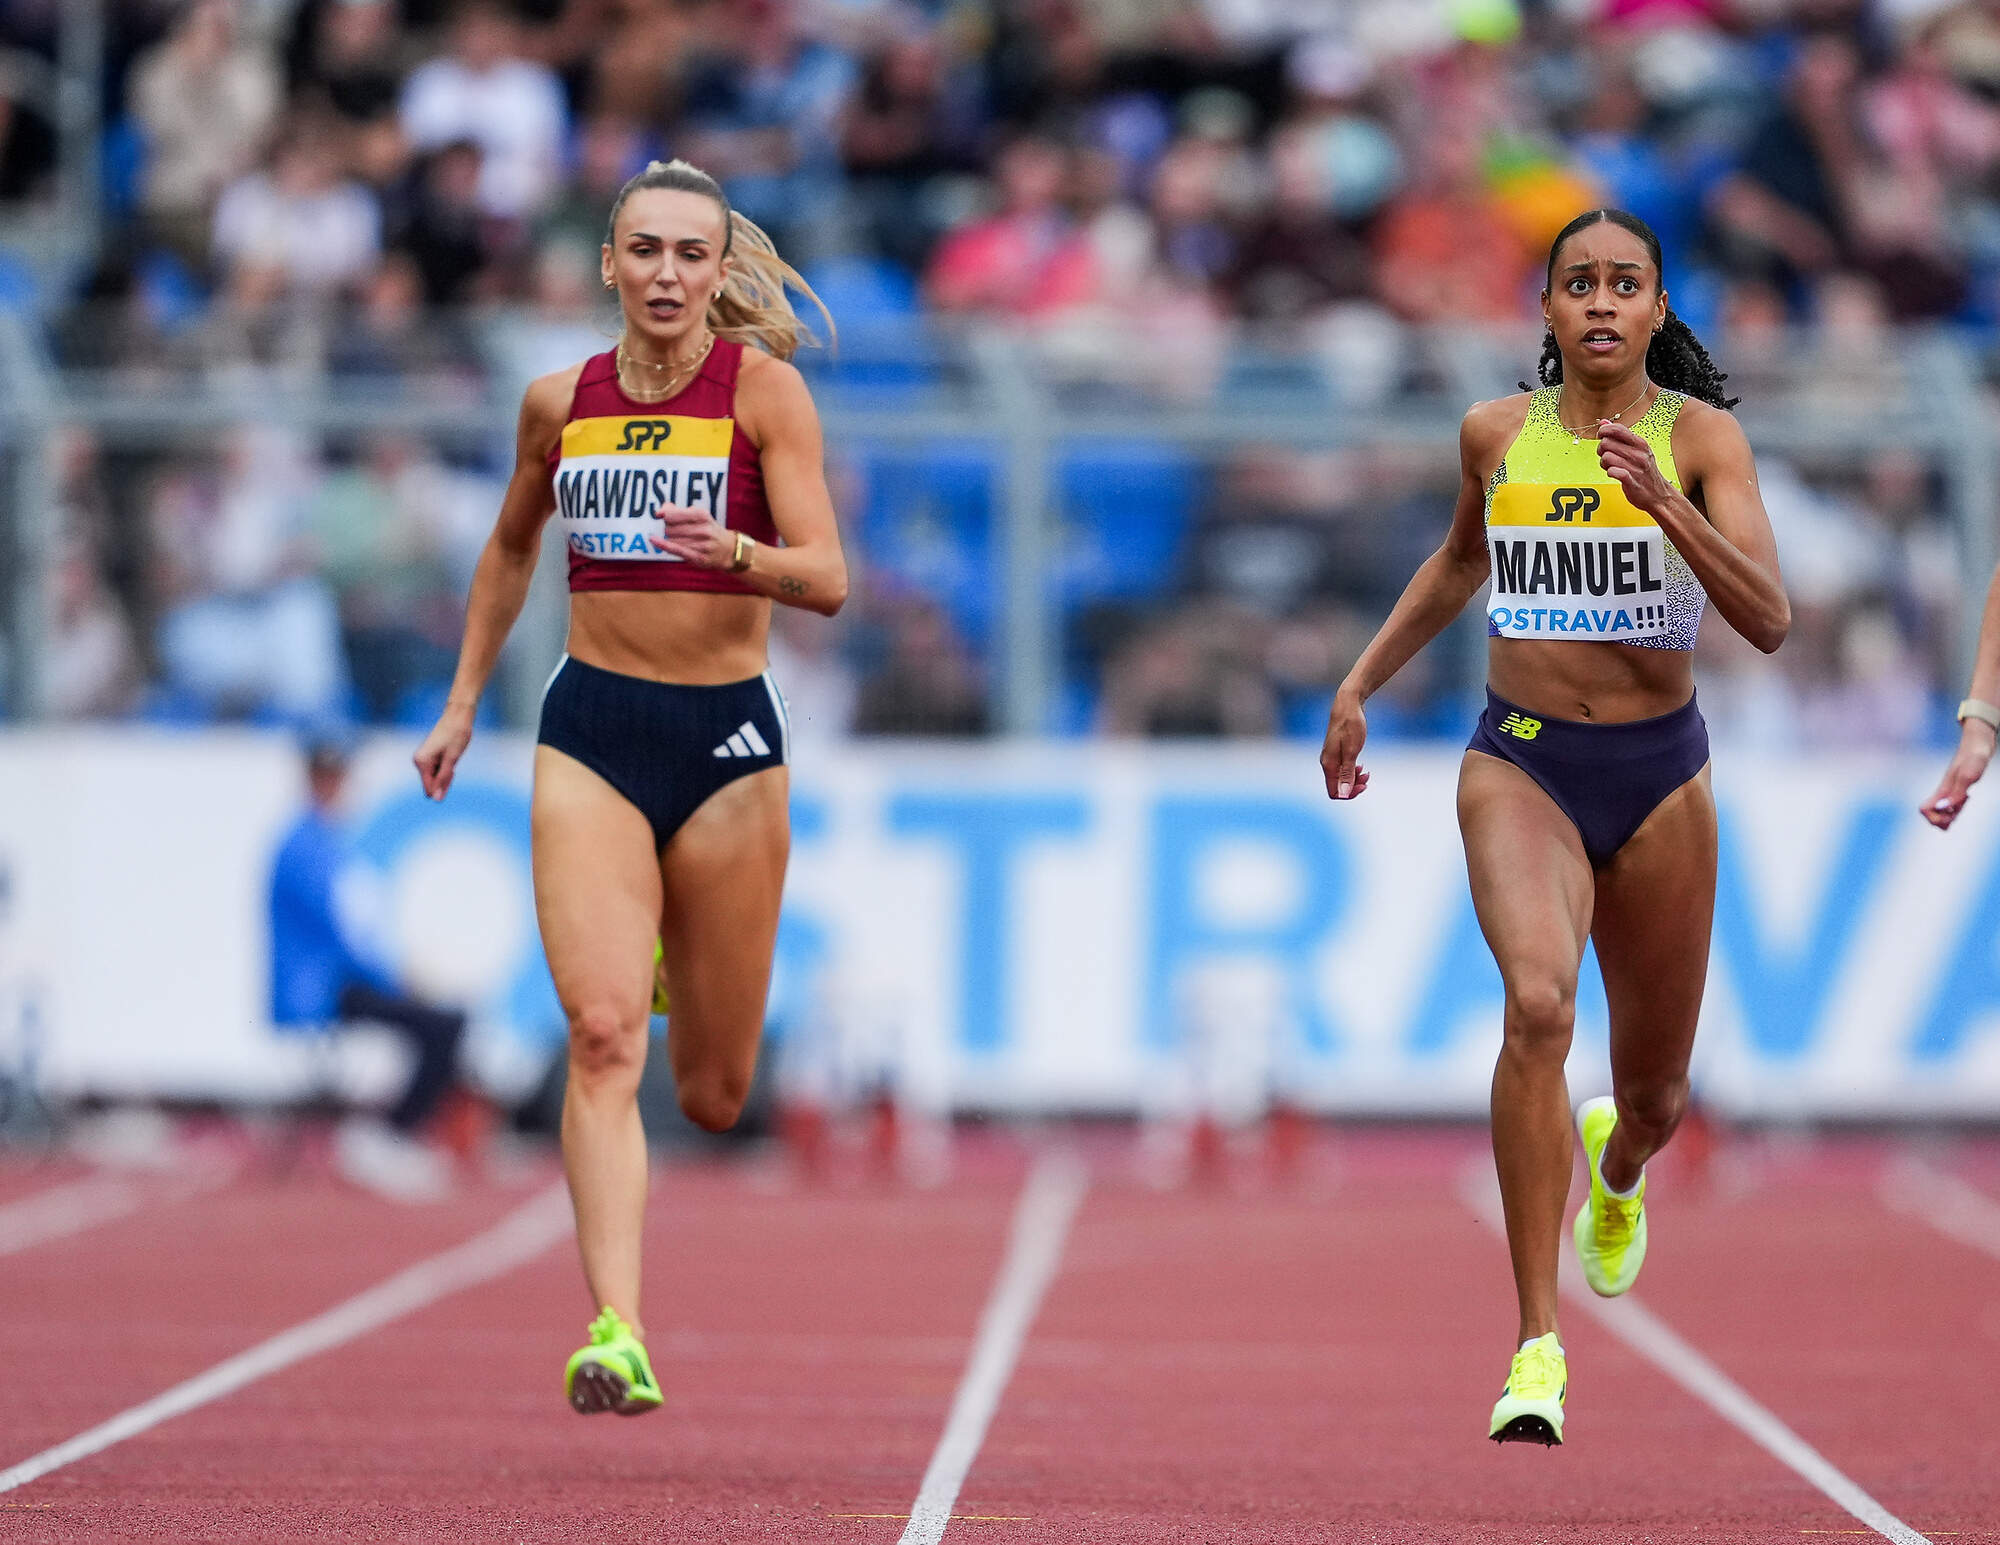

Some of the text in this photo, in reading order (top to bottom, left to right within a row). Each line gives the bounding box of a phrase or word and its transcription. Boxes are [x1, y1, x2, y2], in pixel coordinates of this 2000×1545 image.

[616, 420, 671, 451] SPP
[1545, 487, 1600, 522] SPP
[1494, 540, 1662, 597] MANUEL
[1489, 604, 1665, 633] OSTRAVA!!!
